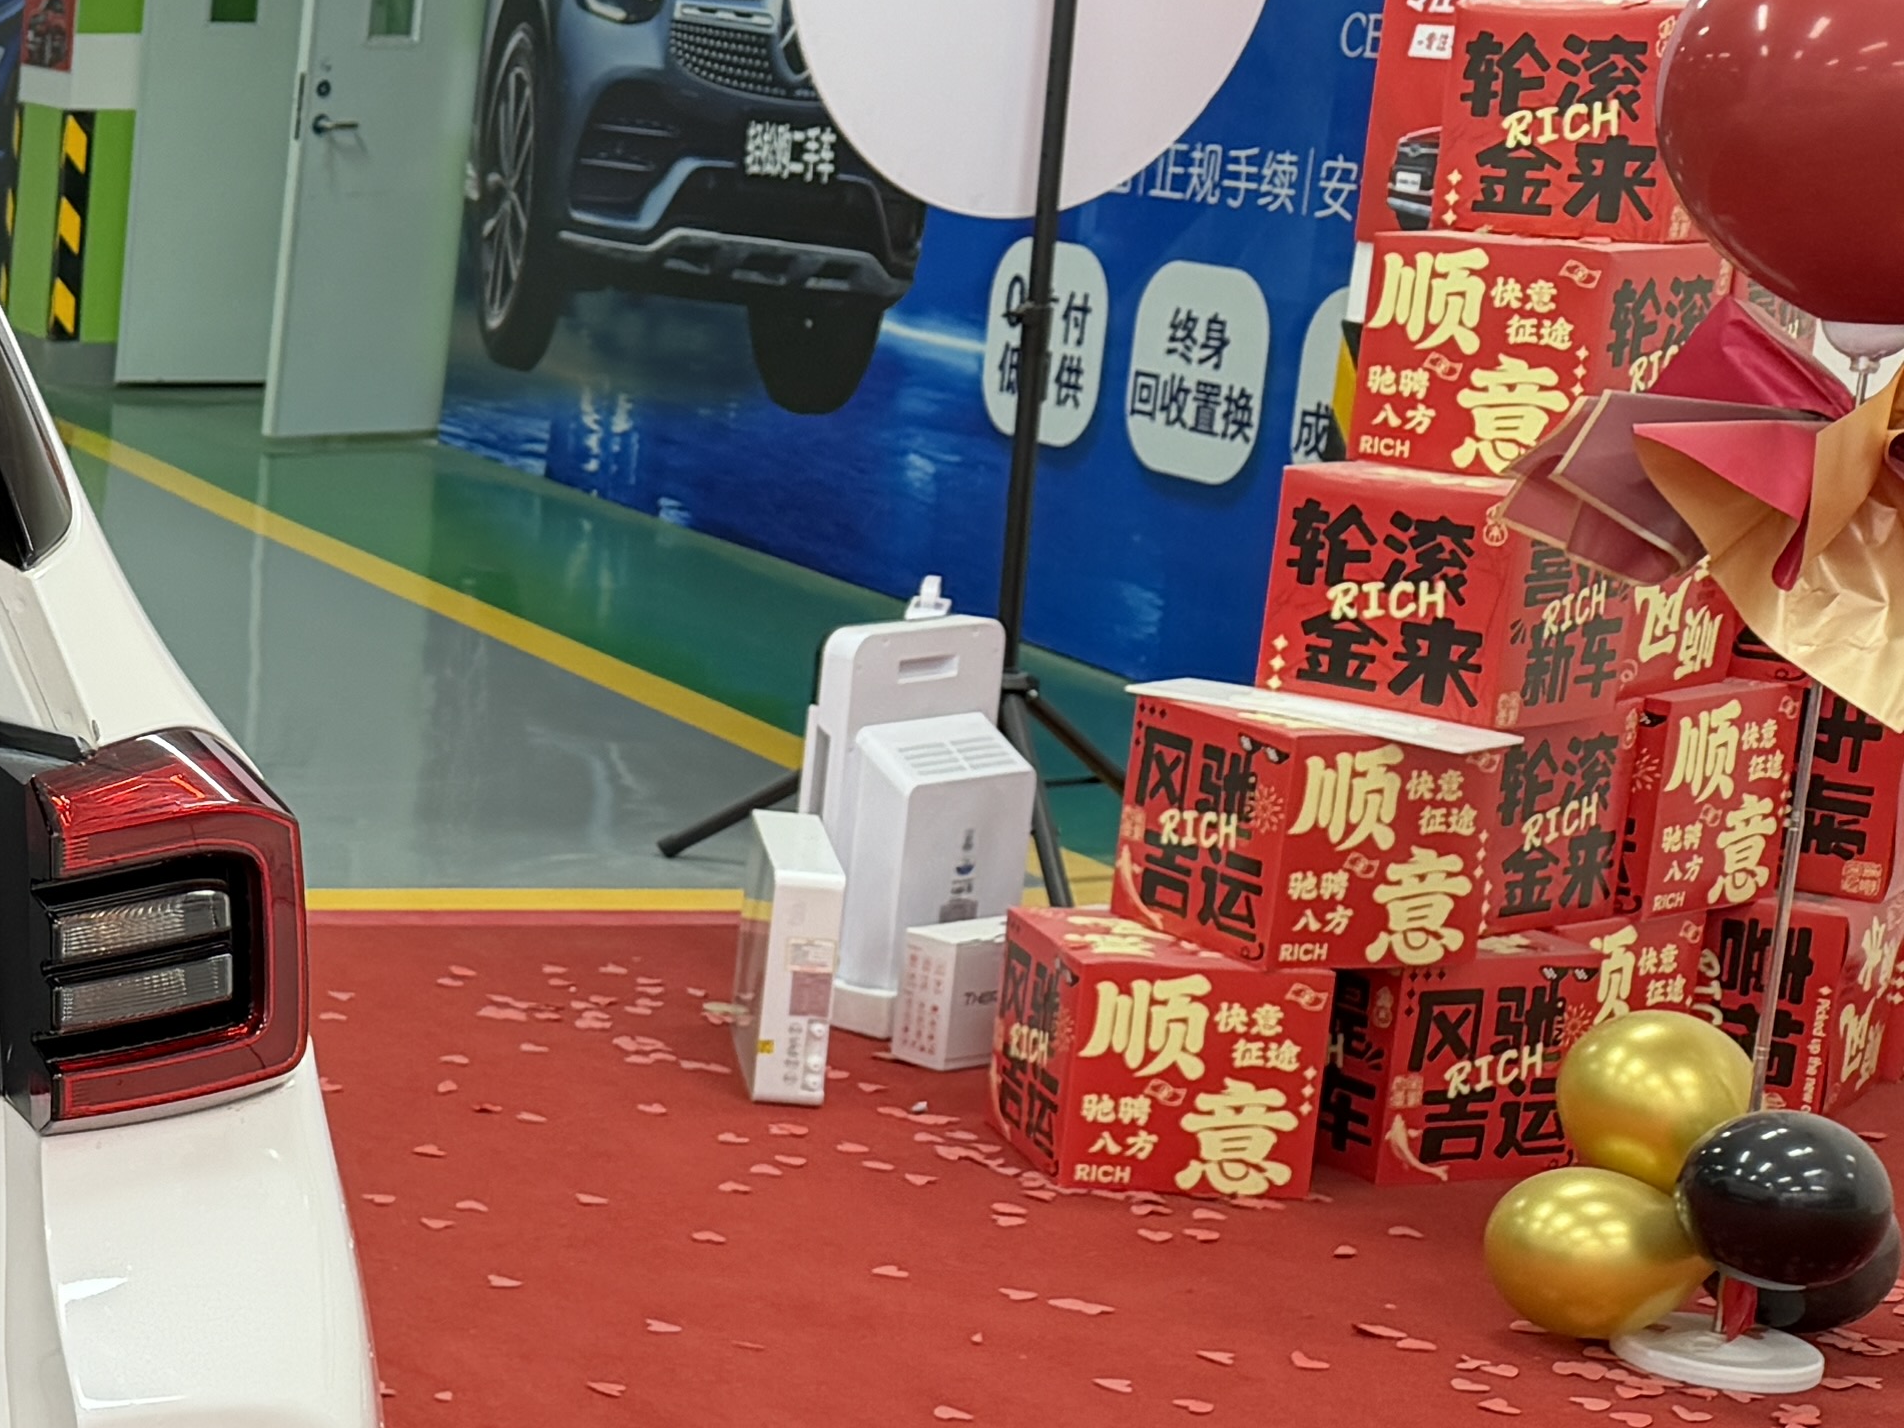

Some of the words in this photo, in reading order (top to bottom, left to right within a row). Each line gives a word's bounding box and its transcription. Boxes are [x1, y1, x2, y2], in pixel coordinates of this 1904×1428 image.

[1460, 31, 1648, 123] 轮滚
[1502, 99, 1619, 149] RICH
[1472, 134, 1657, 224] 金来
[1006, 274, 1092, 347] 0付
[1491, 276, 1558, 313] 快意
[1165, 306, 1231, 370] 终身
[998, 341, 1085, 410] 低供
[1129, 369, 1255, 445] 回收置换
[1371, 403, 1436, 434] 八方
[1359, 435, 1410, 459] RICH
[1287, 498, 1475, 606] 轮滚
[1326, 581, 1447, 620] RICH
[1542, 580, 1607, 640] RICH
[1296, 611, 1483, 708] 金来
[1521, 615, 1623, 707] 新车
[1406, 769, 1464, 802] 快意
[1497, 732, 1618, 827] 轮滚
[1158, 808, 1237, 850] RICH
[1521, 791, 1600, 853] RICH
[1498, 825, 1616, 919] 金来
[1291, 904, 1354, 936] 八方
[1652, 892, 1686, 912] RICH
[1278, 942, 1328, 962] RICH
[1638, 943, 1679, 974] 快意
[1009, 1021, 1049, 1066] RICH
[1214, 1001, 1285, 1036] 快意
[1444, 1042, 1543, 1099] RICH
[1088, 1130, 1159, 1160] 八方
[1074, 1163, 1131, 1184] RICH
